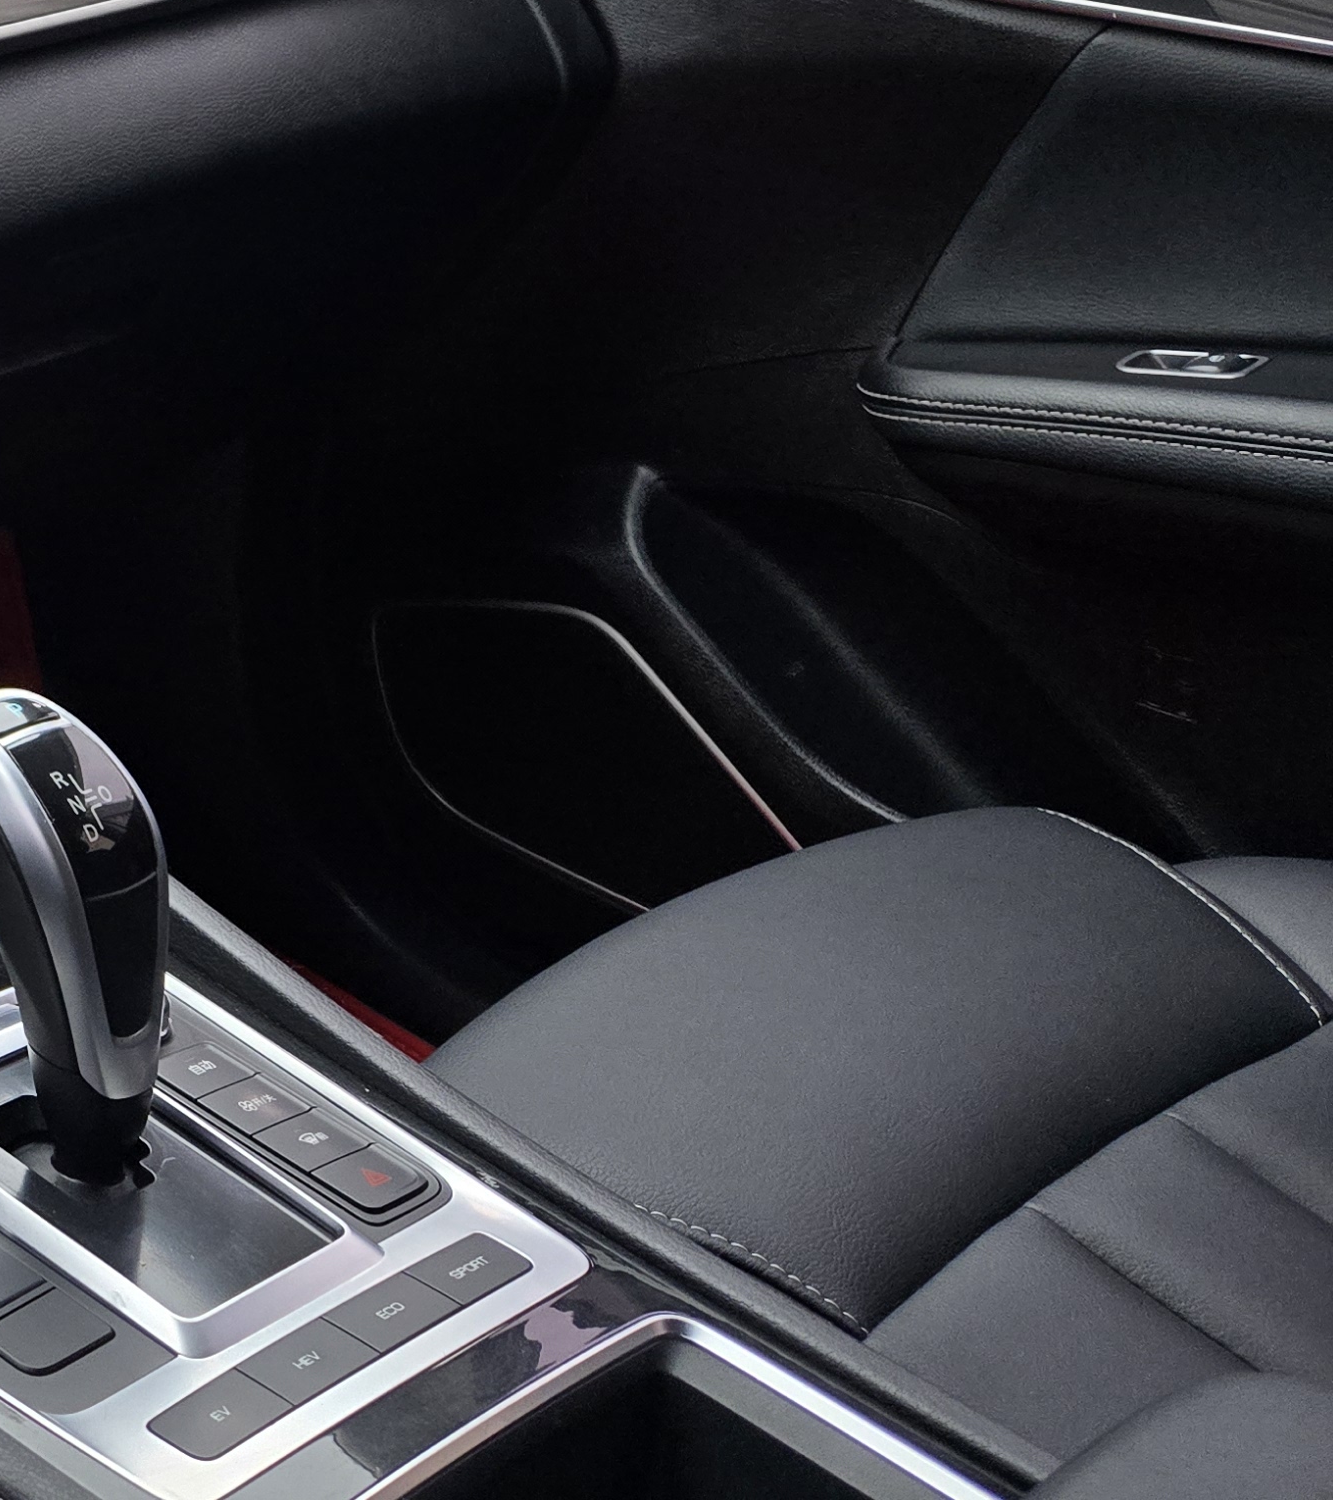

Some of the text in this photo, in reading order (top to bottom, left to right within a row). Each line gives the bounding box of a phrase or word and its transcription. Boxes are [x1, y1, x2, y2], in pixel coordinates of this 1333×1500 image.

[49, 771, 69, 789] R
[66, 795, 86, 816] N
[83, 823, 99, 843] D
[188, 1059, 217, 1076] 自动
[448, 1255, 490, 1279] SPORT
[375, 1301, 405, 1321] ECO
[292, 1350, 321, 1370] HEV
[210, 1405, 231, 1423] EV
